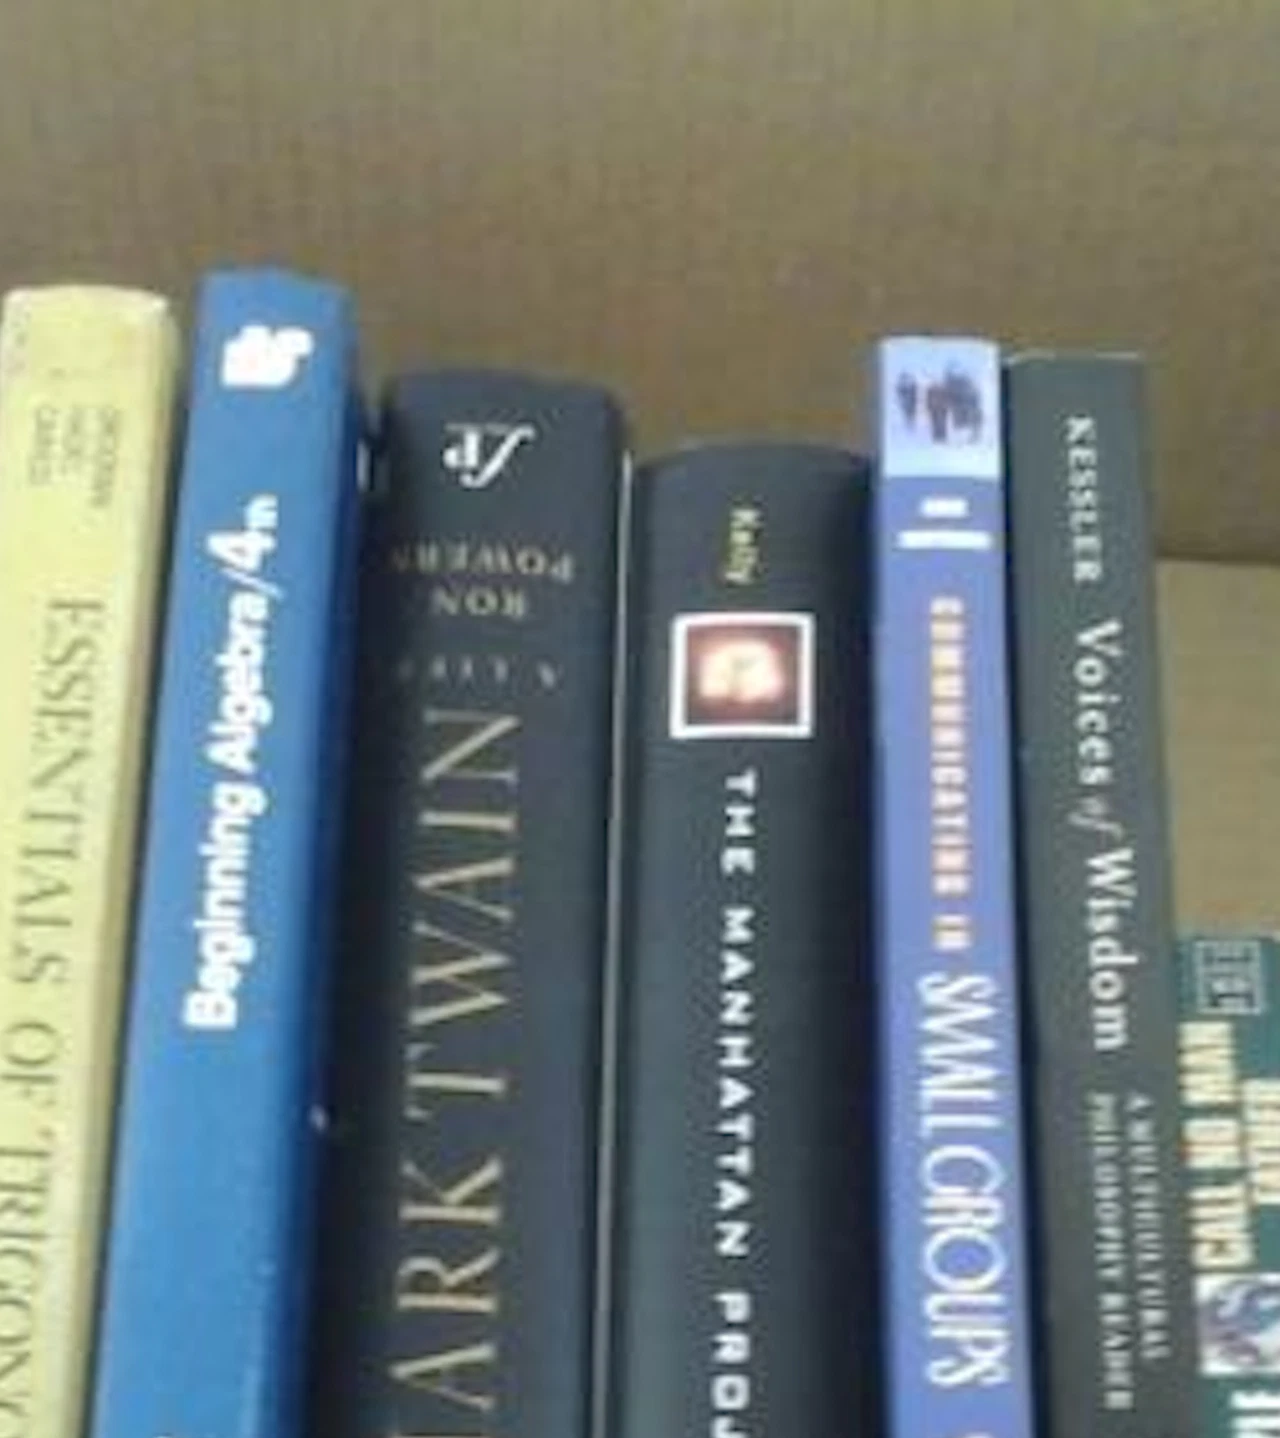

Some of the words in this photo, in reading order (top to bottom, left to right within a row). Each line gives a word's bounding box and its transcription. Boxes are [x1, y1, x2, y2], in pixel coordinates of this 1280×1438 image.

[1064, 414, 1104, 583] KESSLER
[429, 584, 528, 621] RON
[1072, 615, 1128, 786] Voices
[11, 597, 108, 986] ESSENTIALS
[718, 768, 759, 876] THE
[1067, 794, 1125, 838] of
[182, 783, 270, 1029] Beginning
[404, 707, 522, 1122] TWAIN
[1084, 845, 1142, 1051] Wisdom
[710, 905, 757, 1258] MANHATTAN
[916, 971, 1003, 1138] SMALL
[1177, 1020, 1237, 1107] MAN
[1086, 1091, 1128, 1281] PHILOSOPHY
[1180, 1117, 1240, 1169] NO
[1187, 1183, 1252, 1268] CALL
[920, 1144, 1009, 1389] GROUPS
[1124, 1121, 1170, 1361] MULTICULTURAL
[1097, 1292, 1136, 1412] READER
